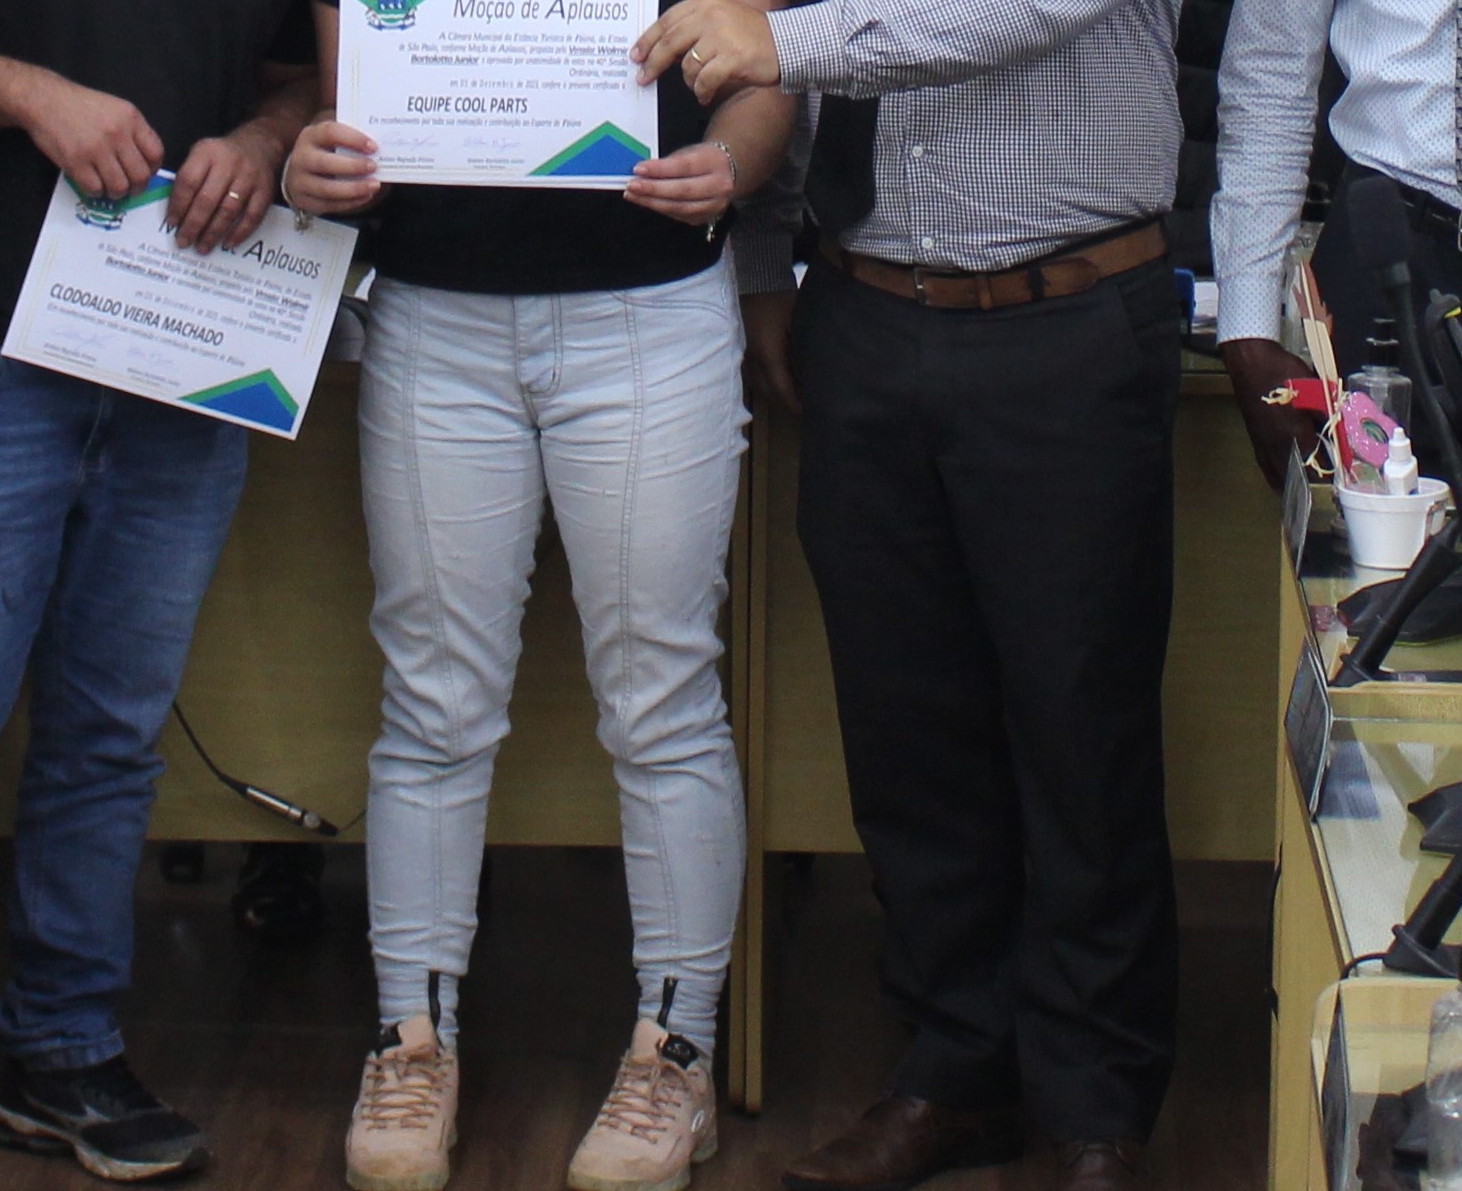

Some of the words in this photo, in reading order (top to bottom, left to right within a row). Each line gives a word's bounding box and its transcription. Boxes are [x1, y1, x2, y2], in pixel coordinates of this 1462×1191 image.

[407, 96, 451, 114] EQUIPE
[454, 96, 486, 114] COOL
[489, 97, 528, 114] PARTS
[243, 240, 322, 279] Aplausos
[50, 283, 123, 316] CLODOALDO
[123, 305, 161, 326] VIEIRA
[161, 316, 225, 346] MACHADO
